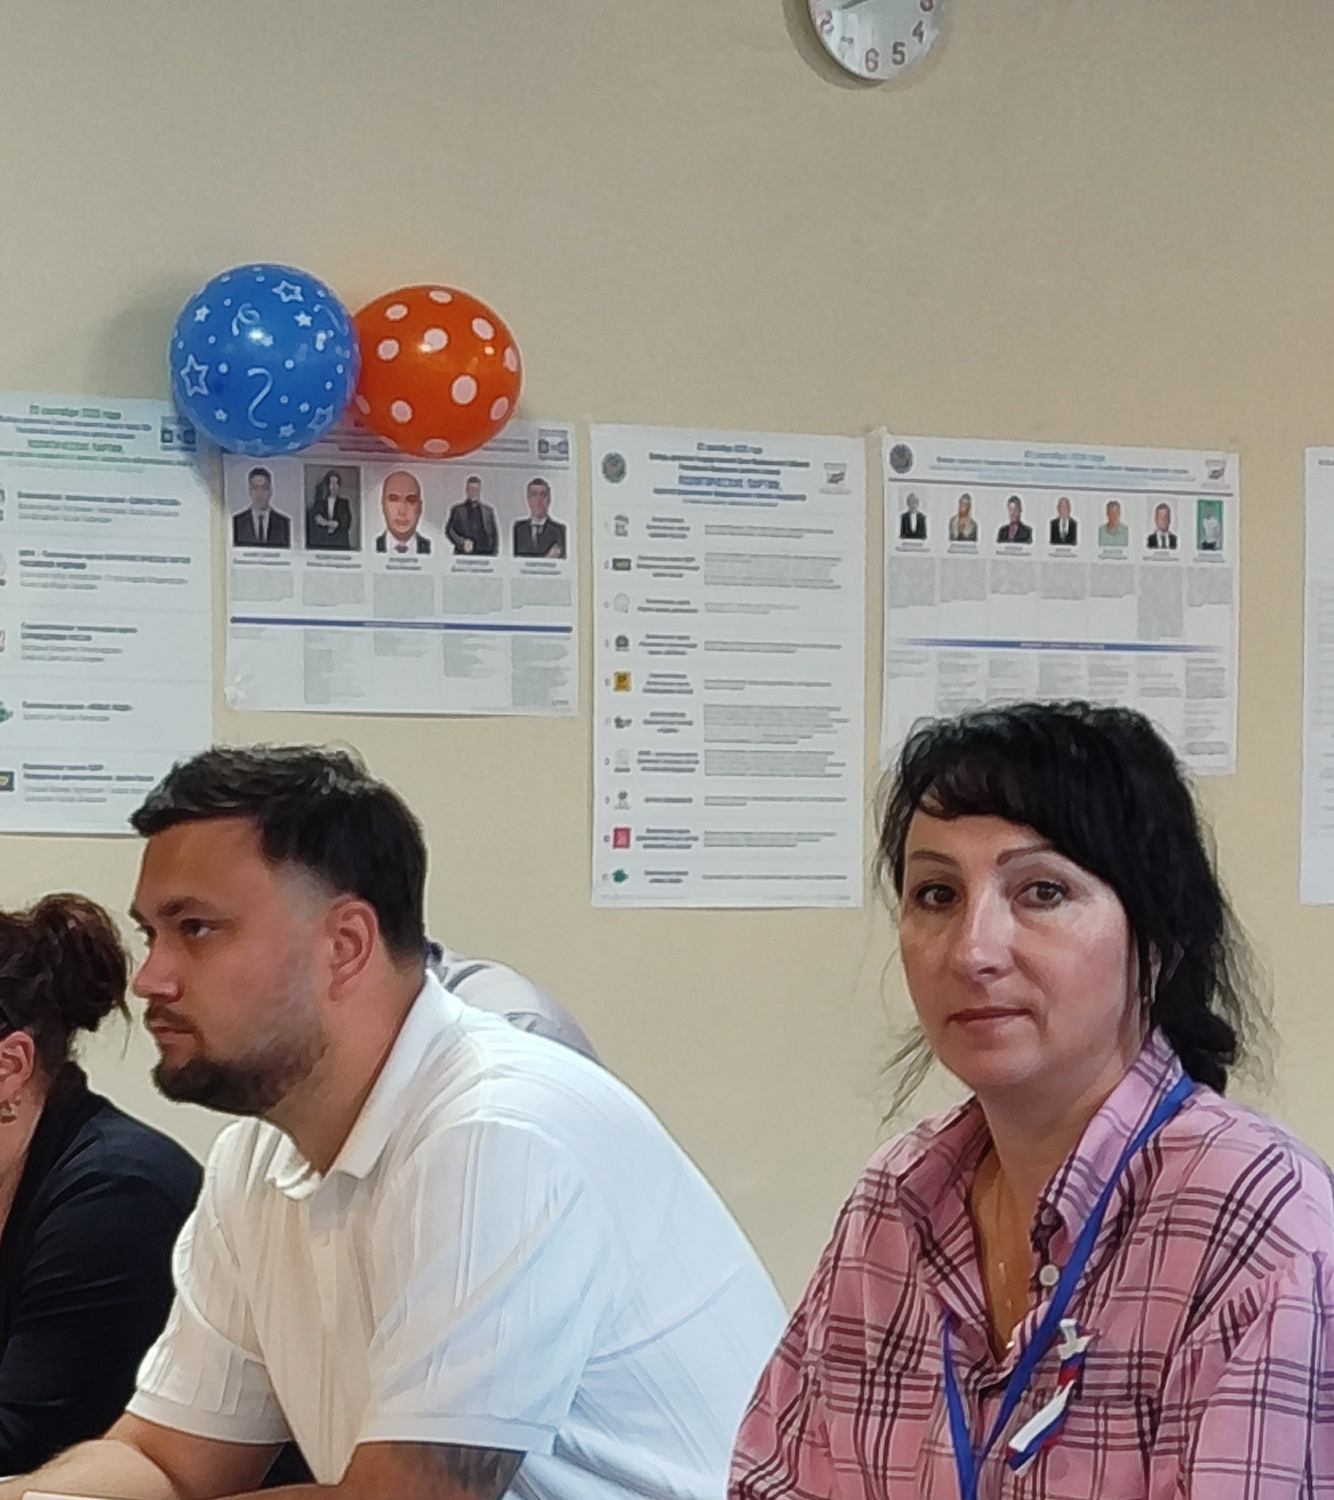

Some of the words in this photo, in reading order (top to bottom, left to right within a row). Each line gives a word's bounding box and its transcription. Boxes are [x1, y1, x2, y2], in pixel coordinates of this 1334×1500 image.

[912, 20, 925, 43] 4
[865, 48, 879, 72] 6
[892, 41, 906, 65] 5
